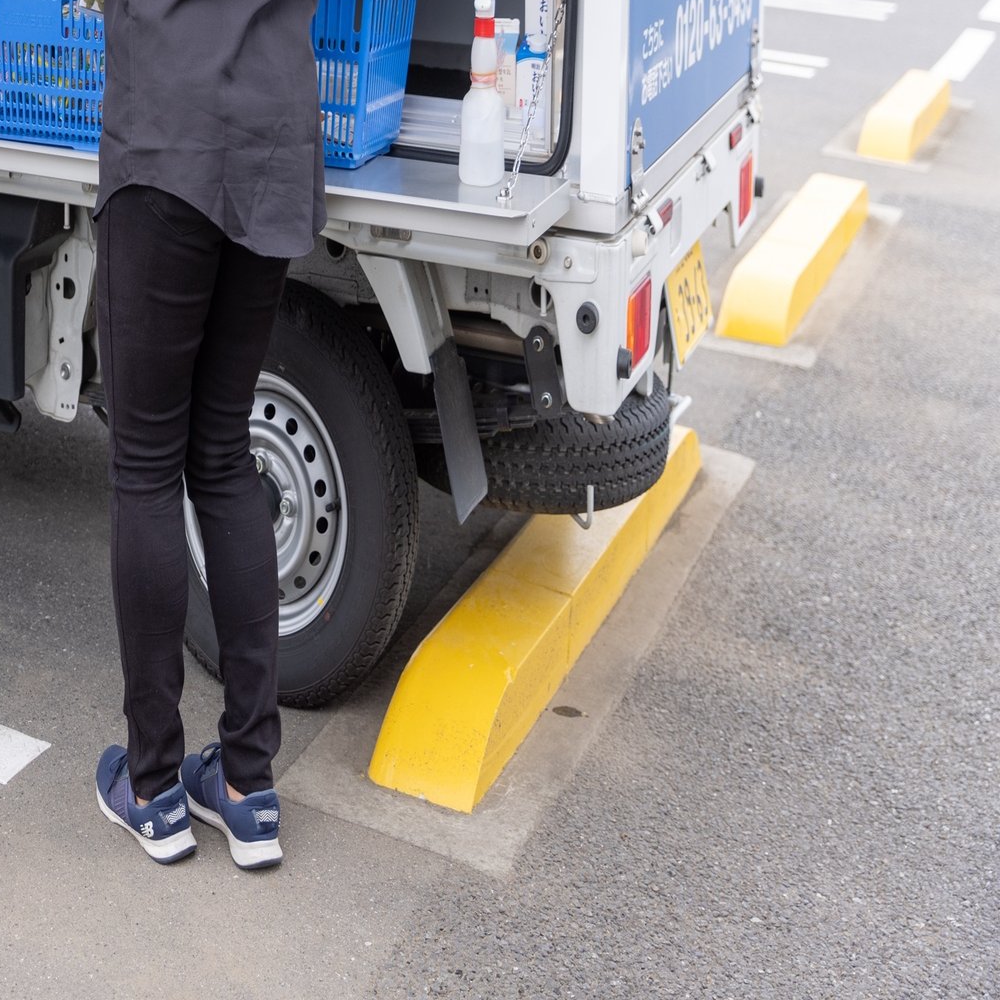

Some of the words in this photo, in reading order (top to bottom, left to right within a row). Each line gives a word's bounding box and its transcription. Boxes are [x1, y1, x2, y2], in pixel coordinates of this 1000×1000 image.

[642, 19, 665, 60] こちらに
[641, 55, 674, 106] お電話下さい
